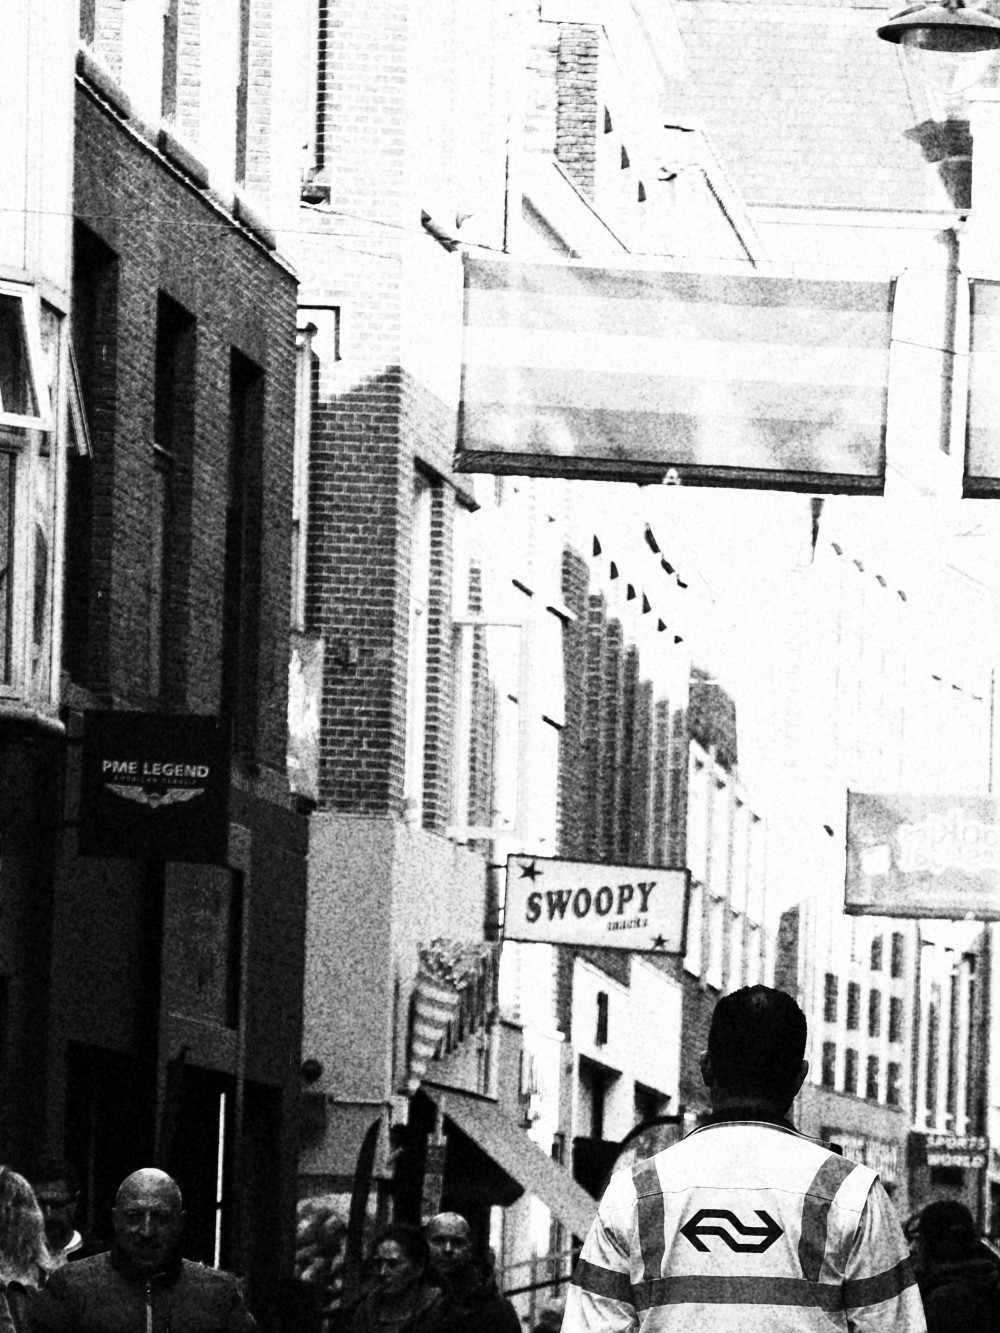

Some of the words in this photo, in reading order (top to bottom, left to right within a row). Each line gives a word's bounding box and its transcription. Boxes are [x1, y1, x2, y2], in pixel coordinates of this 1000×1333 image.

[102, 760, 138, 774] PME
[143, 762, 210, 778] LEGEND
[525, 881, 657, 924] SWOOPY
[926, 1135, 987, 1151] SPORTS
[926, 1153, 987, 1169] WORLD
